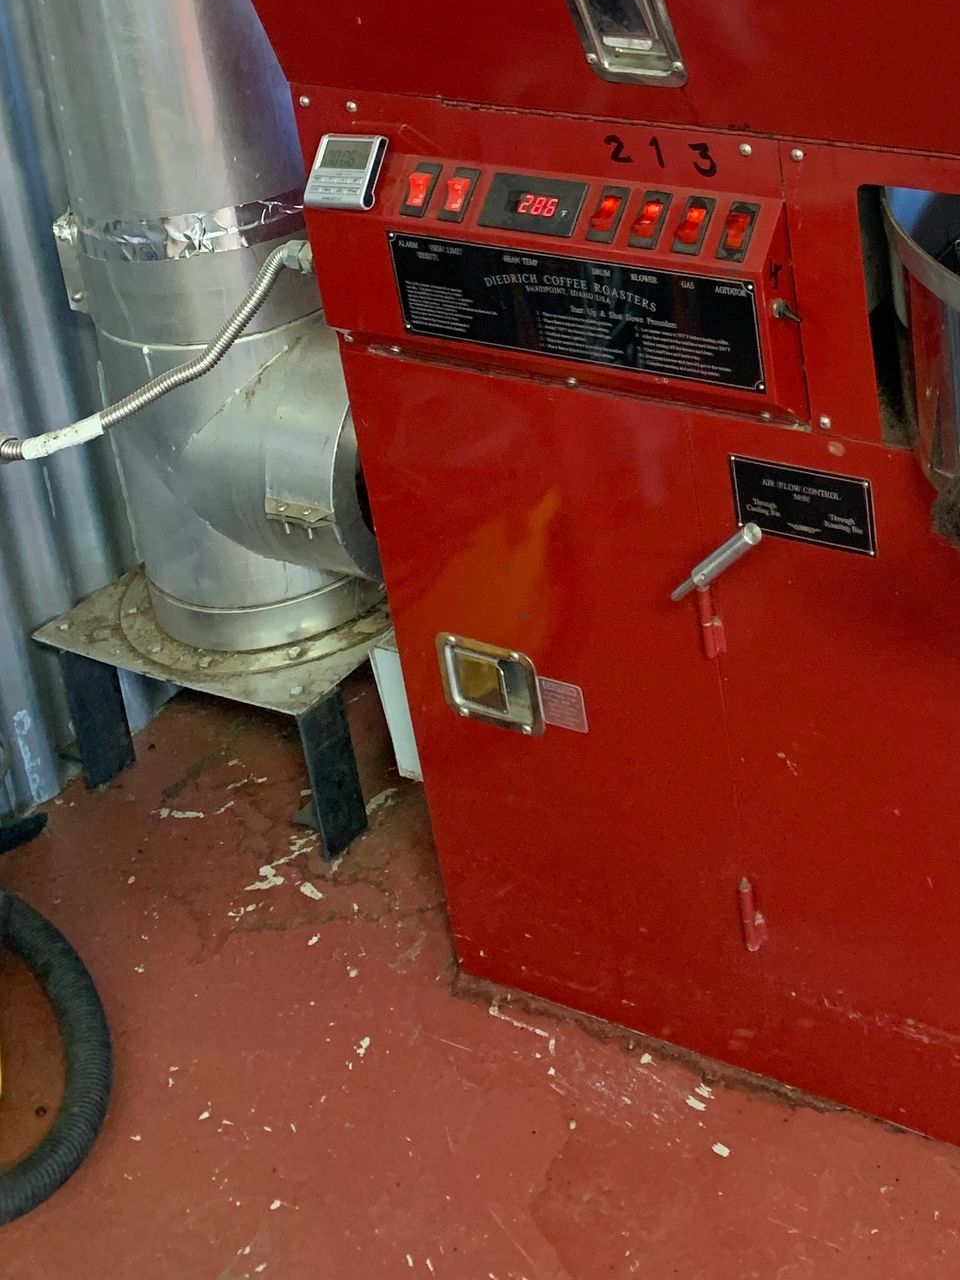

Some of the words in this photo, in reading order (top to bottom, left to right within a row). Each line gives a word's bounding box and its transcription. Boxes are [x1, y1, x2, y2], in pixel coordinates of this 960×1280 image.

[603, 134, 634, 163] 2
[648, 136, 665, 168] 1
[688, 142, 717, 177] 3
[517, 194, 559, 218] 286
[591, 268, 611, 277] DRUM
[630, 273, 658, 284] BLOWER
[680, 280, 695, 290] GAS
[484, 273, 538, 287] DIEDRICH
[543, 275, 588, 290] COFFEE
[593, 282, 657, 312] ROASTERS
[595, 294, 611, 305] USA
